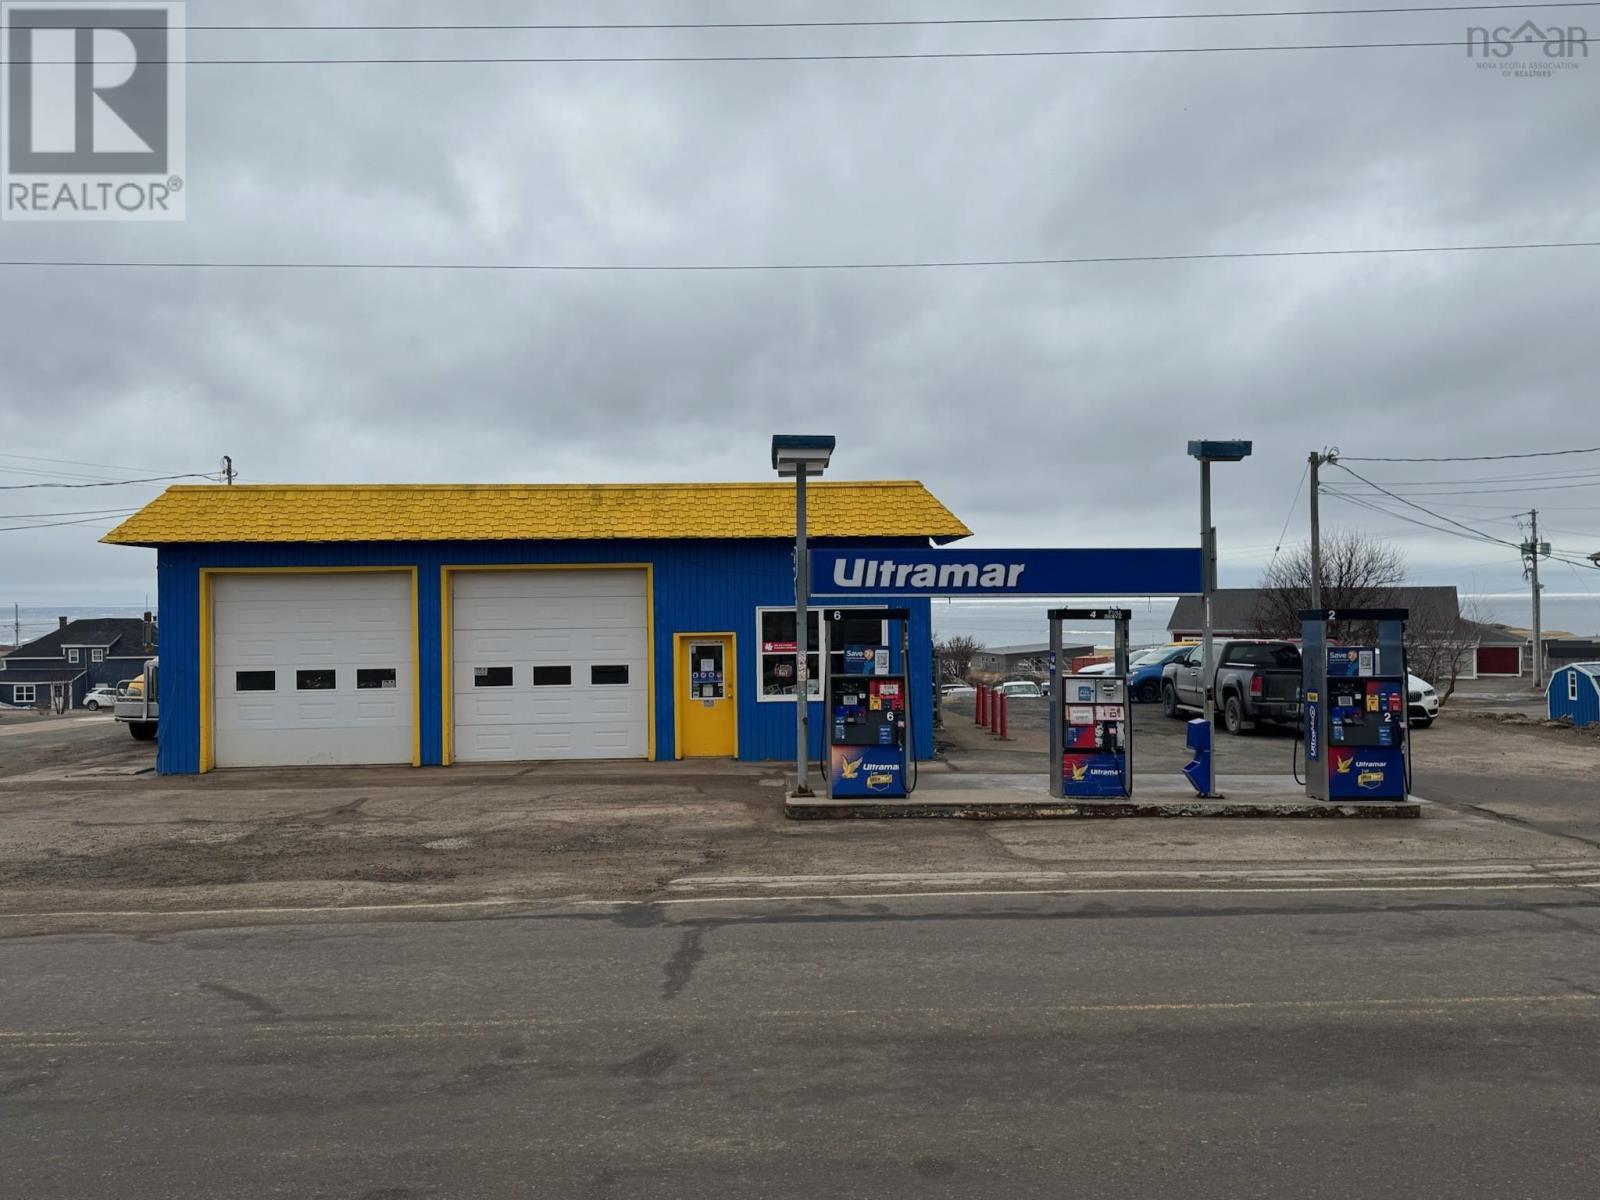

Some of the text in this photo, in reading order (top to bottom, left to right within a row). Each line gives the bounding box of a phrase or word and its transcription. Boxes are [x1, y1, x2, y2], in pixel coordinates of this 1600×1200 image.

[833, 558, 1025, 588] Ultramar
[833, 610, 841, 620] 6
[1089, 610, 1097, 619] 4
[1328, 610, 1336, 620] 2
[1329, 651, 1347, 659] Save
[886, 711, 894, 721] 6
[1384, 712, 1392, 722] 2
[863, 763, 900, 771] Ultrama
